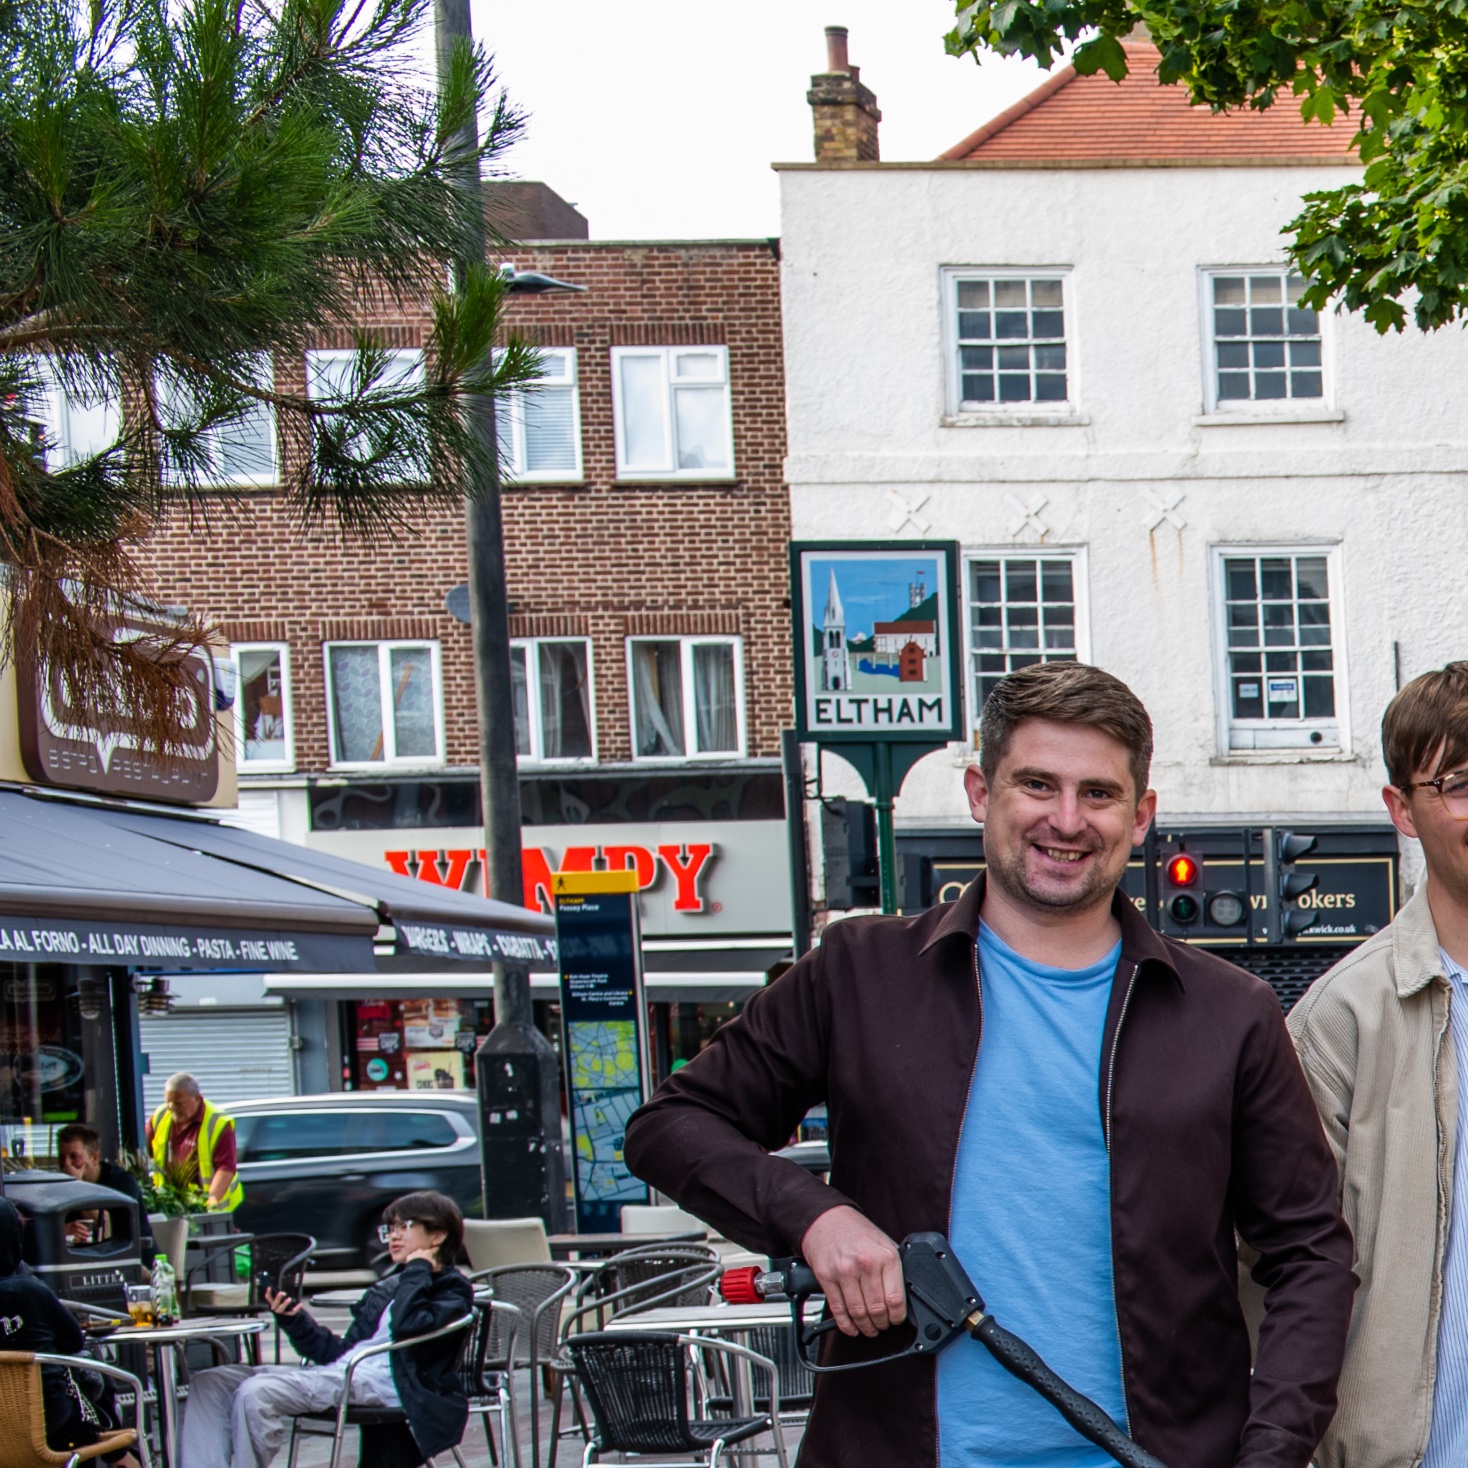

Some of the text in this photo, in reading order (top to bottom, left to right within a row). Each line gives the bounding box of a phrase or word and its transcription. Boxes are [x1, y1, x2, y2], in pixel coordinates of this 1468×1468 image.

[815, 698, 943, 725] ELTHAM
[559, 905, 581, 913] Passey
[13, 930, 34, 952] AL
[32, 930, 80, 954] FORNO
[89, 933, 117, 954] ALL
[113, 934, 139, 956] DAY
[140, 935, 191, 958] DINNING
[196, 938, 235, 960] PASTA
[240, 941, 266, 961] FINE
[266, 941, 299, 961] WINE
